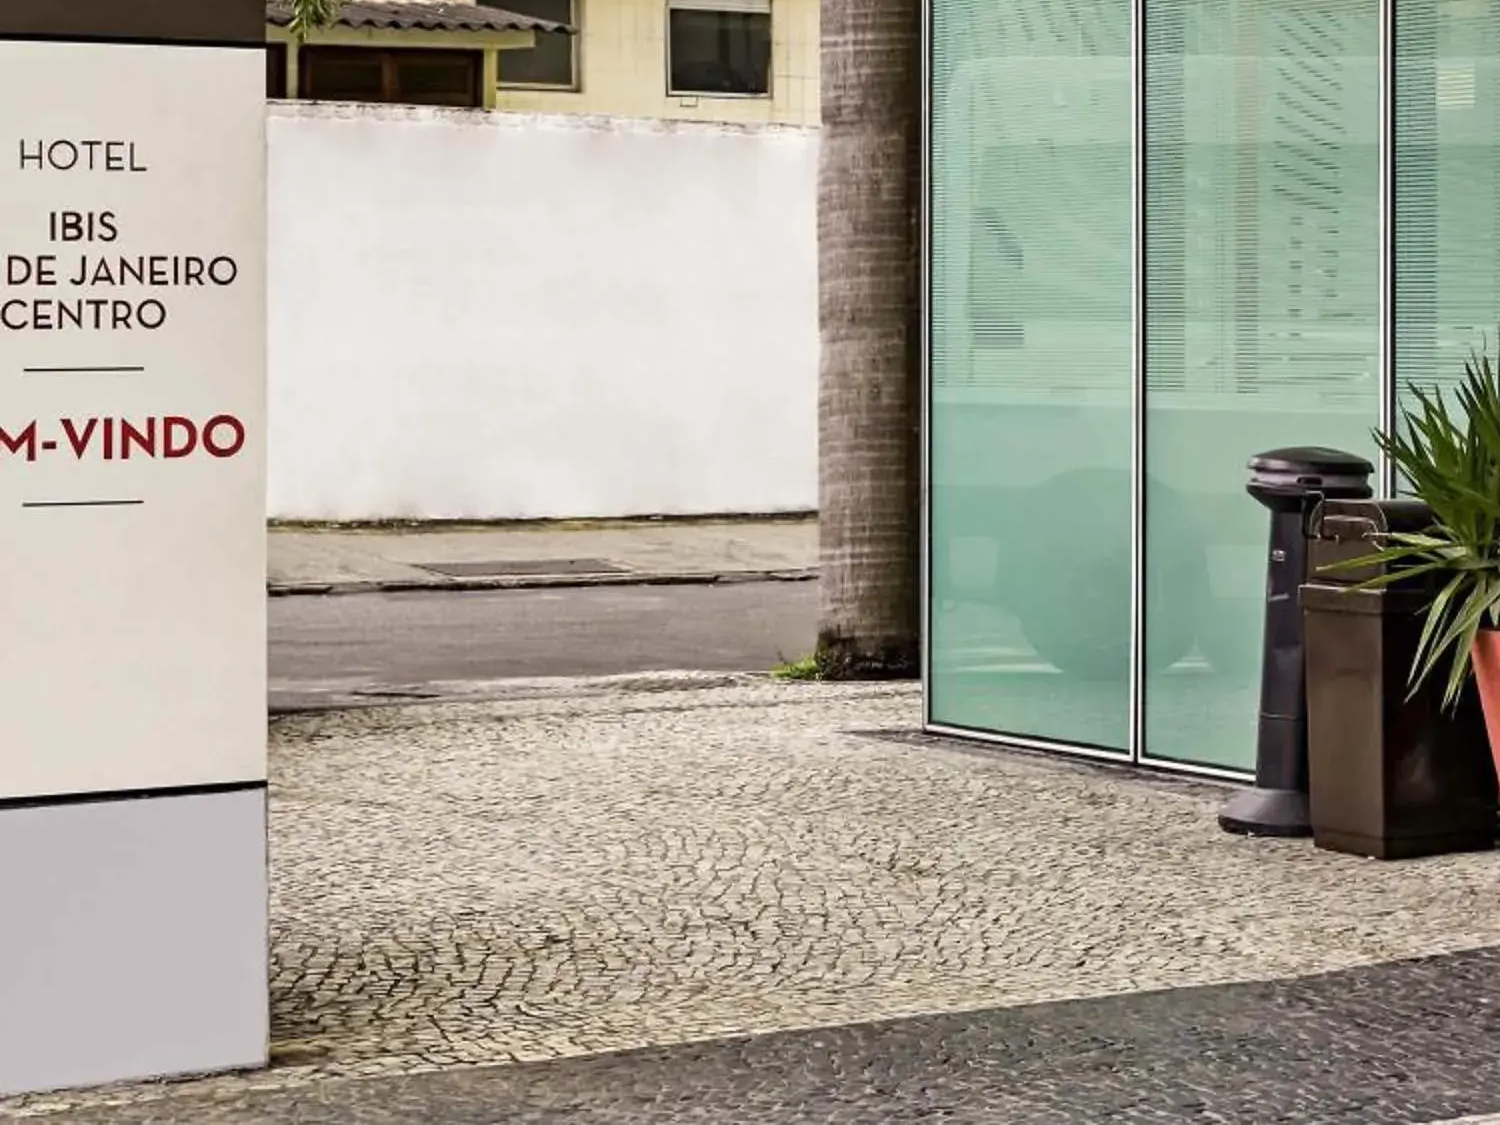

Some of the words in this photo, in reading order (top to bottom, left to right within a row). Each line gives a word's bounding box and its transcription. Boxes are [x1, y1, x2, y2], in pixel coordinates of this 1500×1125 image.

[19, 138, 148, 172] HOTEL
[49, 211, 118, 242] IBIS
[7, 255, 57, 286] DE
[70, 255, 238, 286] JANEIRO
[1, 298, 167, 330] CENTRO
